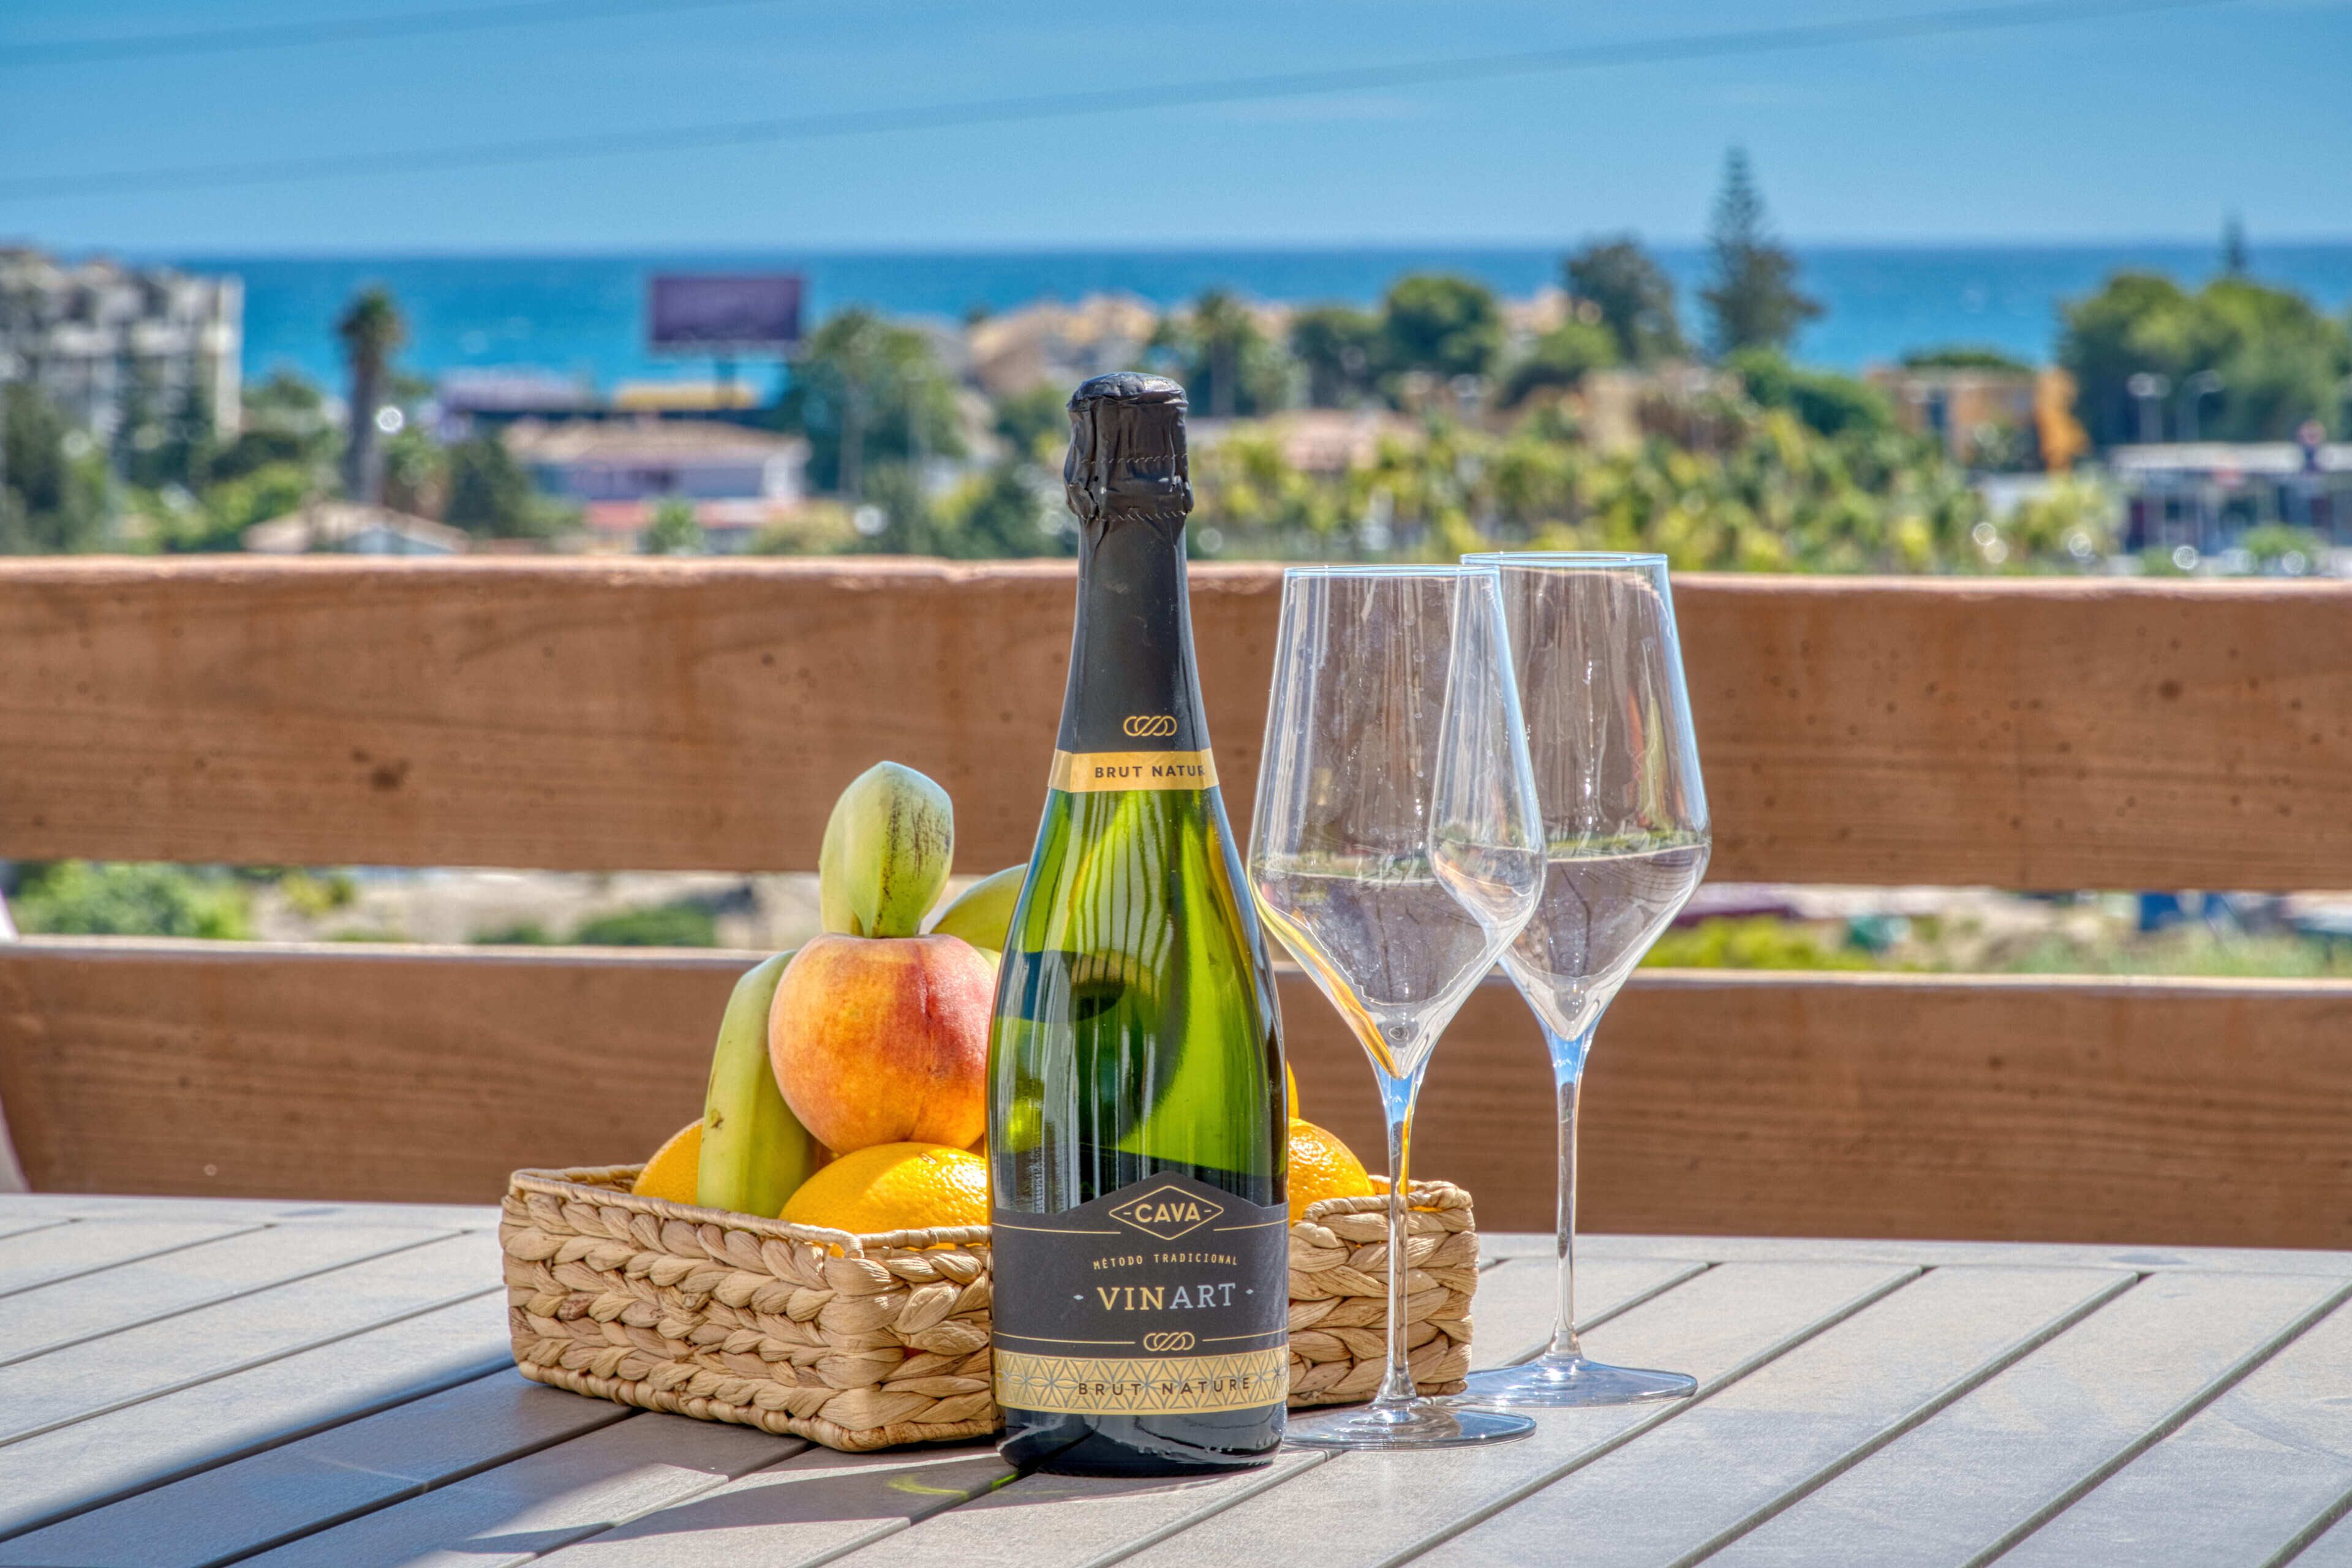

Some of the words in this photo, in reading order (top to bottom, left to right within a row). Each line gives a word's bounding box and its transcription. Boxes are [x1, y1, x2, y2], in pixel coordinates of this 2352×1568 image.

[1095, 766, 1142, 778] BRUT
[1135, 1202, 1201, 1223] CAVA
[1154, 1253, 1237, 1265] TRADICIONAL
[1097, 1283, 1235, 1310] VINART
[1078, 1383, 1141, 1396] BRUT
[1162, 1378, 1250, 1395] NATURE
